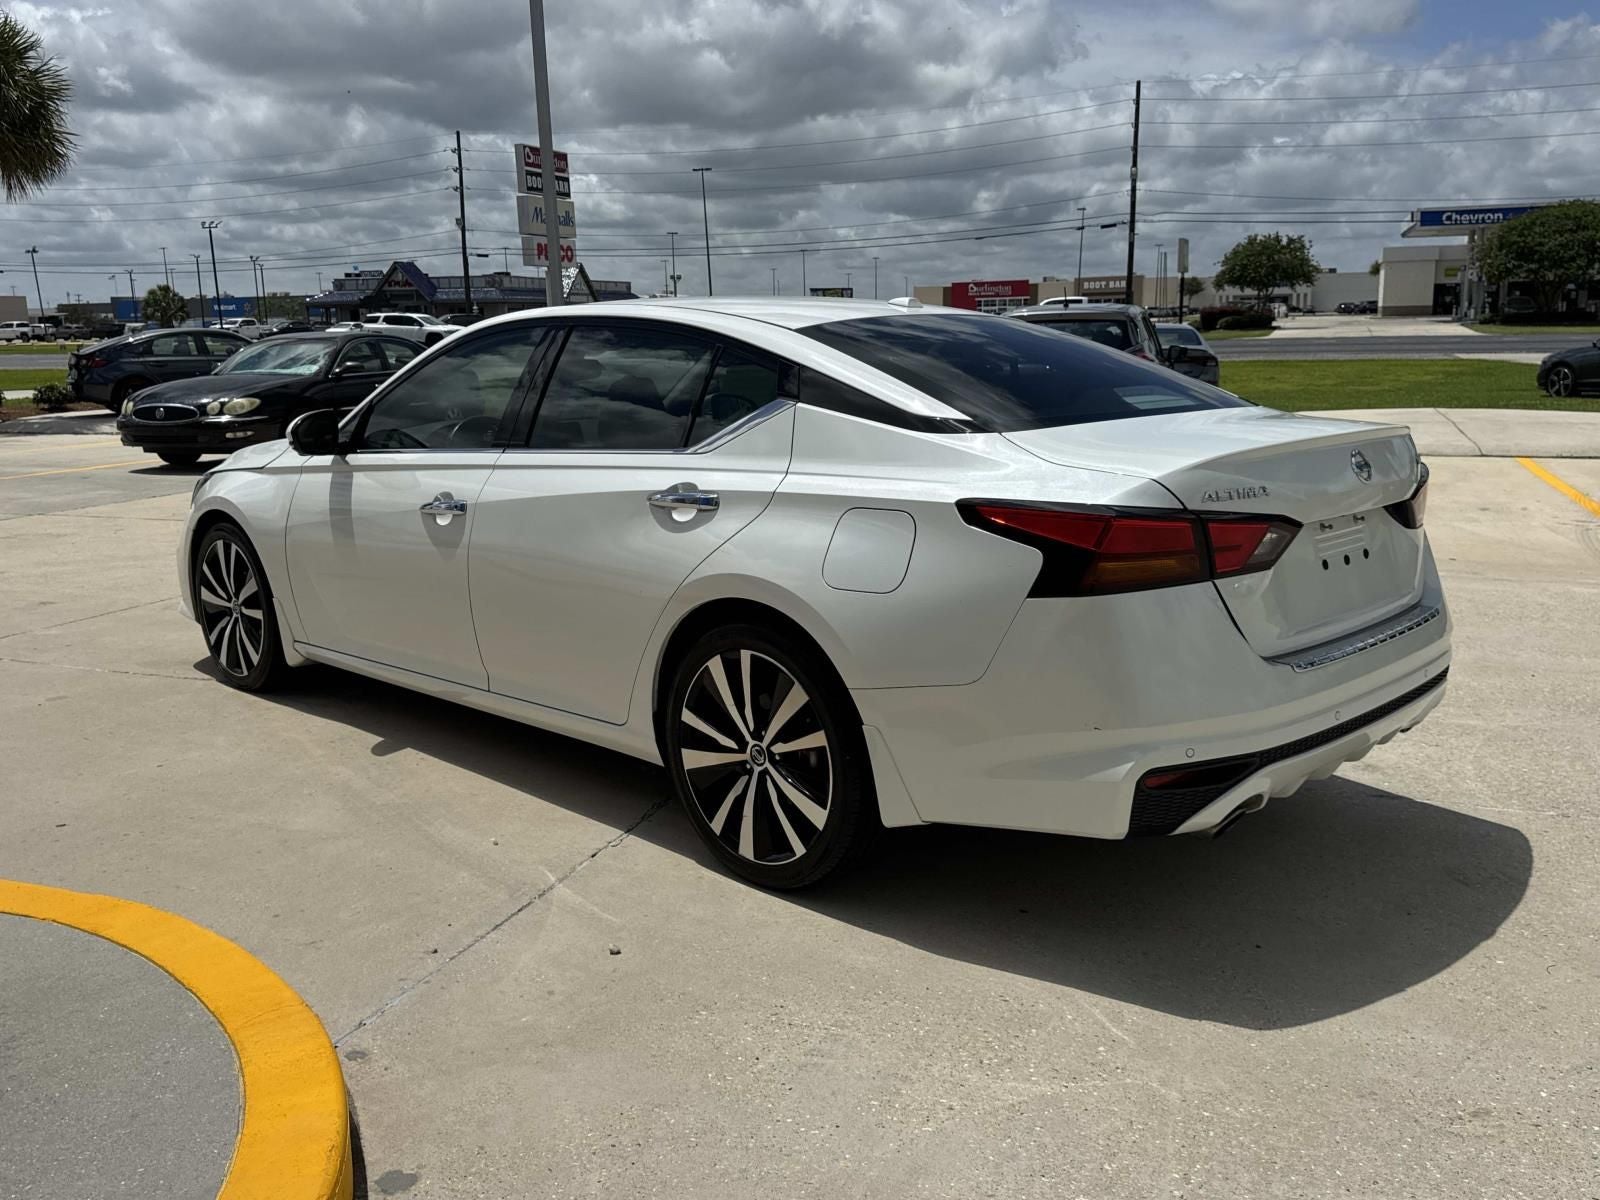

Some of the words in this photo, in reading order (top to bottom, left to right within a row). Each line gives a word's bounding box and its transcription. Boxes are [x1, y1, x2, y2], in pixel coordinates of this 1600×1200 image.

[525, 147, 567, 168] Burton
[526, 175, 545, 190] BOO
[553, 179, 569, 193] ARN
[1442, 211, 1503, 225] Chevron
[537, 242, 574, 263] PECO
[968, 283, 1012, 293] Burlington
[1083, 281, 1106, 289] BOOT
[1109, 280, 1127, 289] BAR
[1201, 485, 1270, 503] ALTIMA
